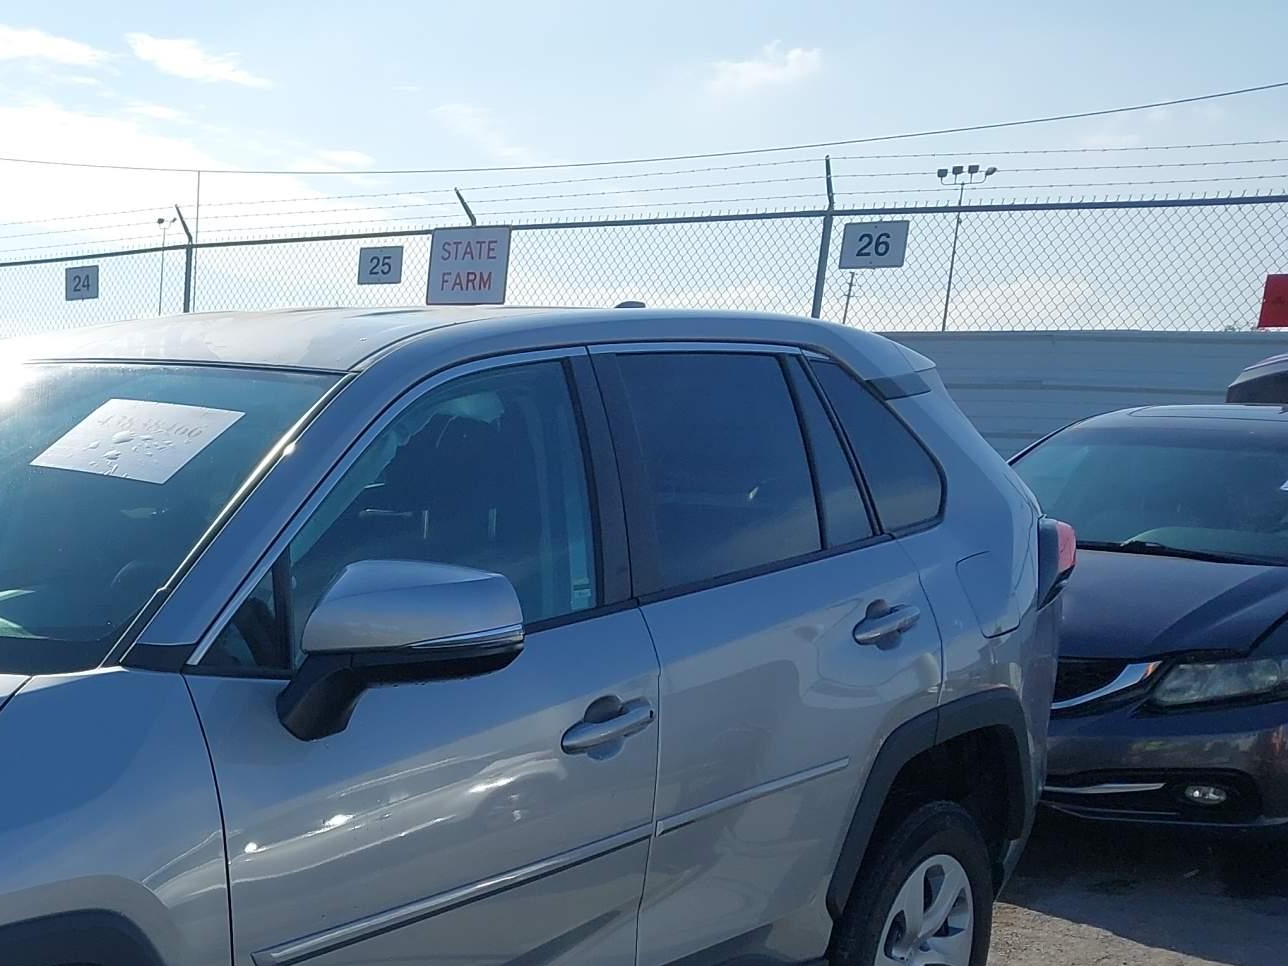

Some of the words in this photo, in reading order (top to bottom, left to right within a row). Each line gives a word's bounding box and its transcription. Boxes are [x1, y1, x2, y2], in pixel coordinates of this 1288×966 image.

[441, 240, 498, 261] STATE
[855, 232, 891, 257] 26
[369, 256, 392, 275] 25
[73, 275, 90, 292] 24
[440, 271, 492, 292] FARM
